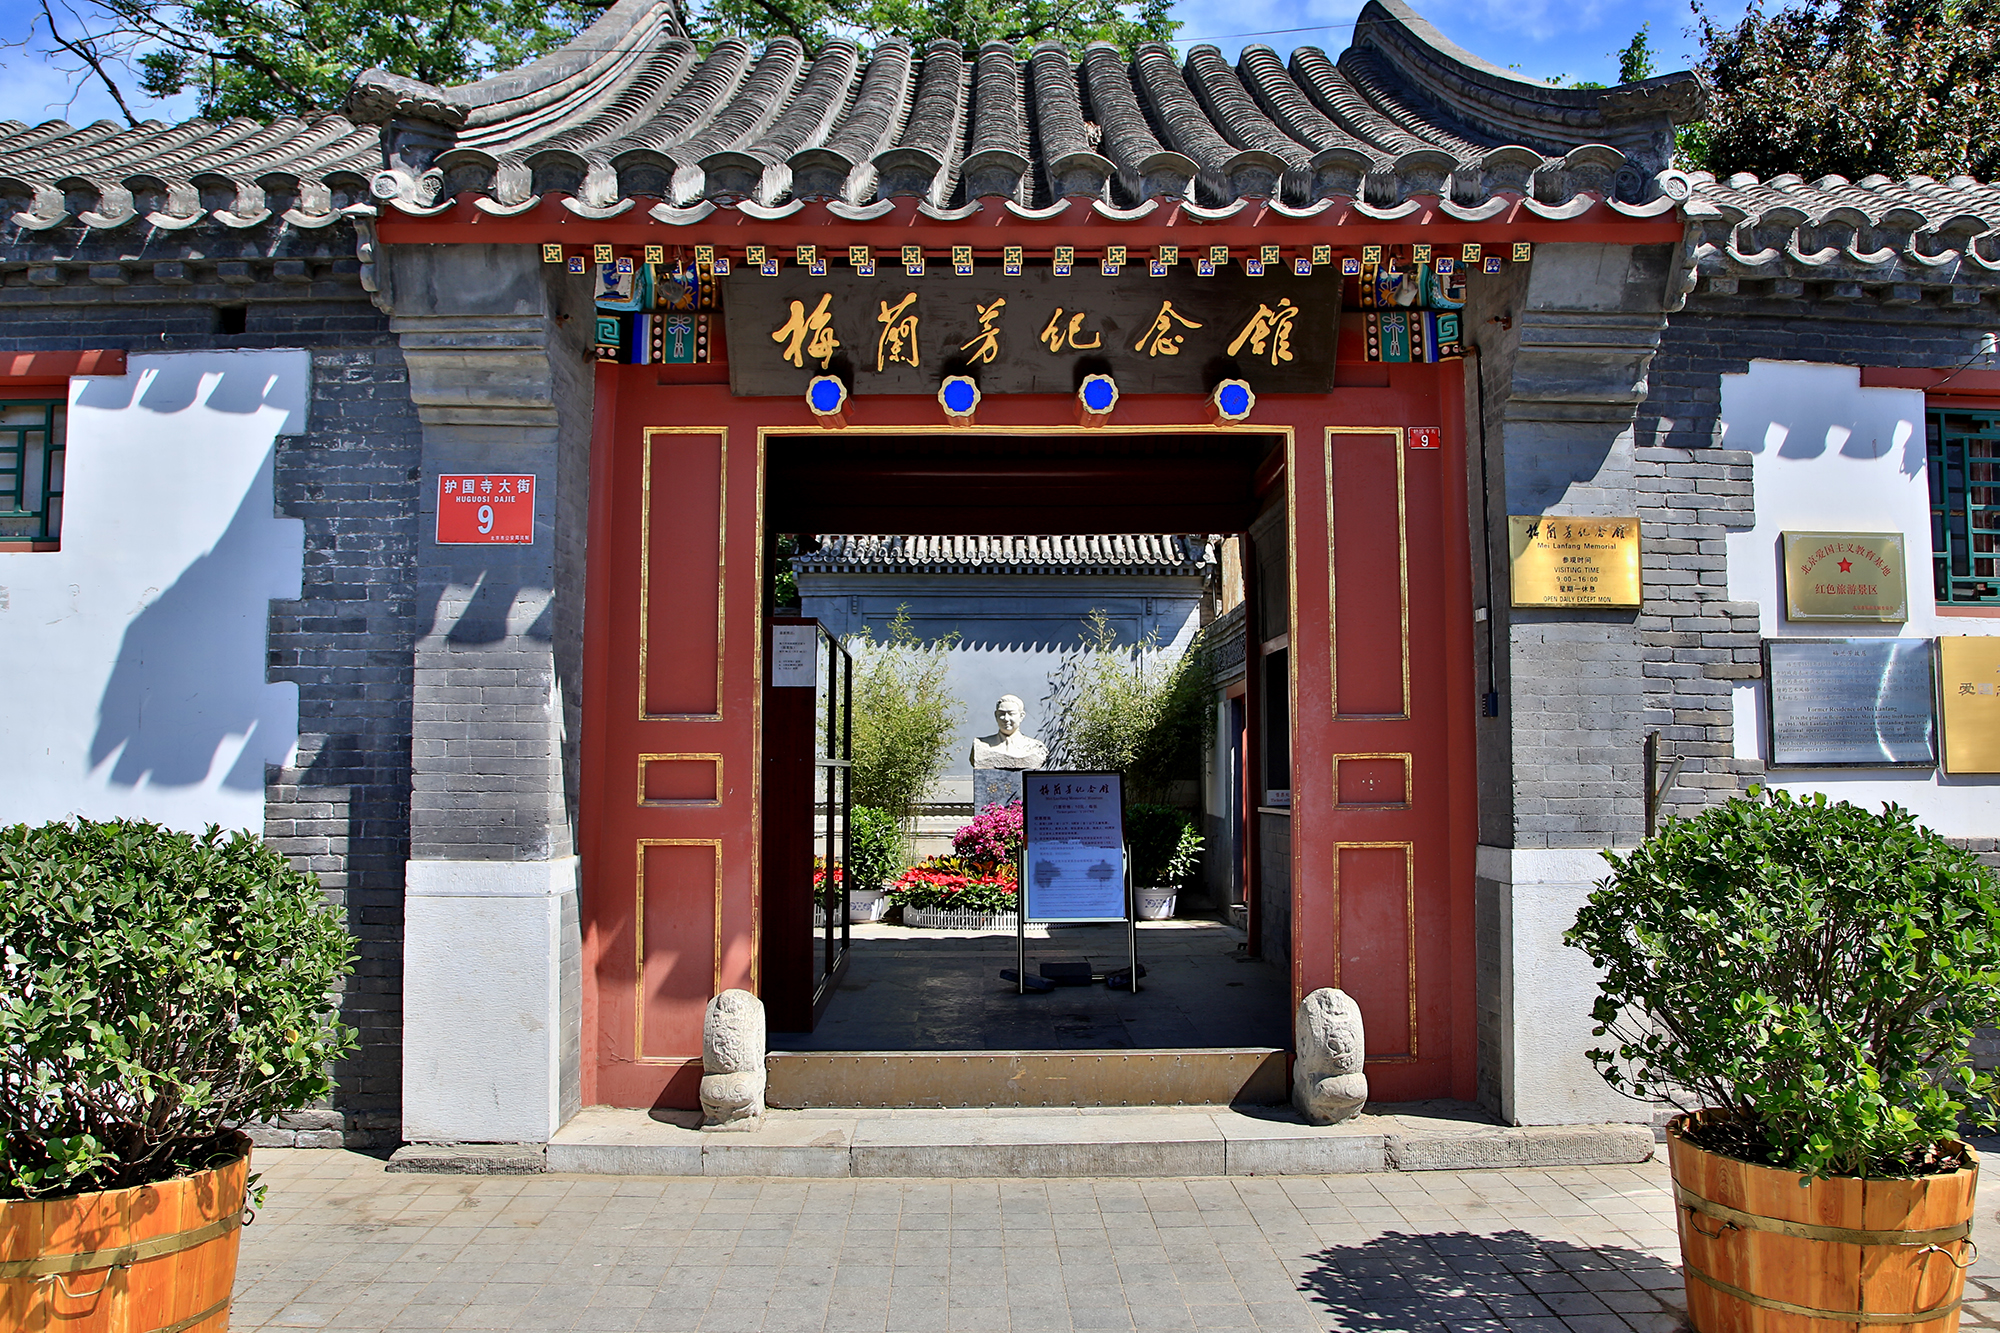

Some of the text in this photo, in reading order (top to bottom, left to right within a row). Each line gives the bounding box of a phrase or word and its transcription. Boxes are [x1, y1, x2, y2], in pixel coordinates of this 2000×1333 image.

[1421, 435, 1429, 447] 9
[445, 479, 530, 493] 护国寺大街
[477, 505, 494, 534] 9
[1801, 543, 1891, 577] 北京爱国主义教育基地
[1560, 585, 1596, 593] 星期一休息
[1815, 584, 1878, 595] 红色旅游景区
[1958, 682, 2000, 697] 爱国
